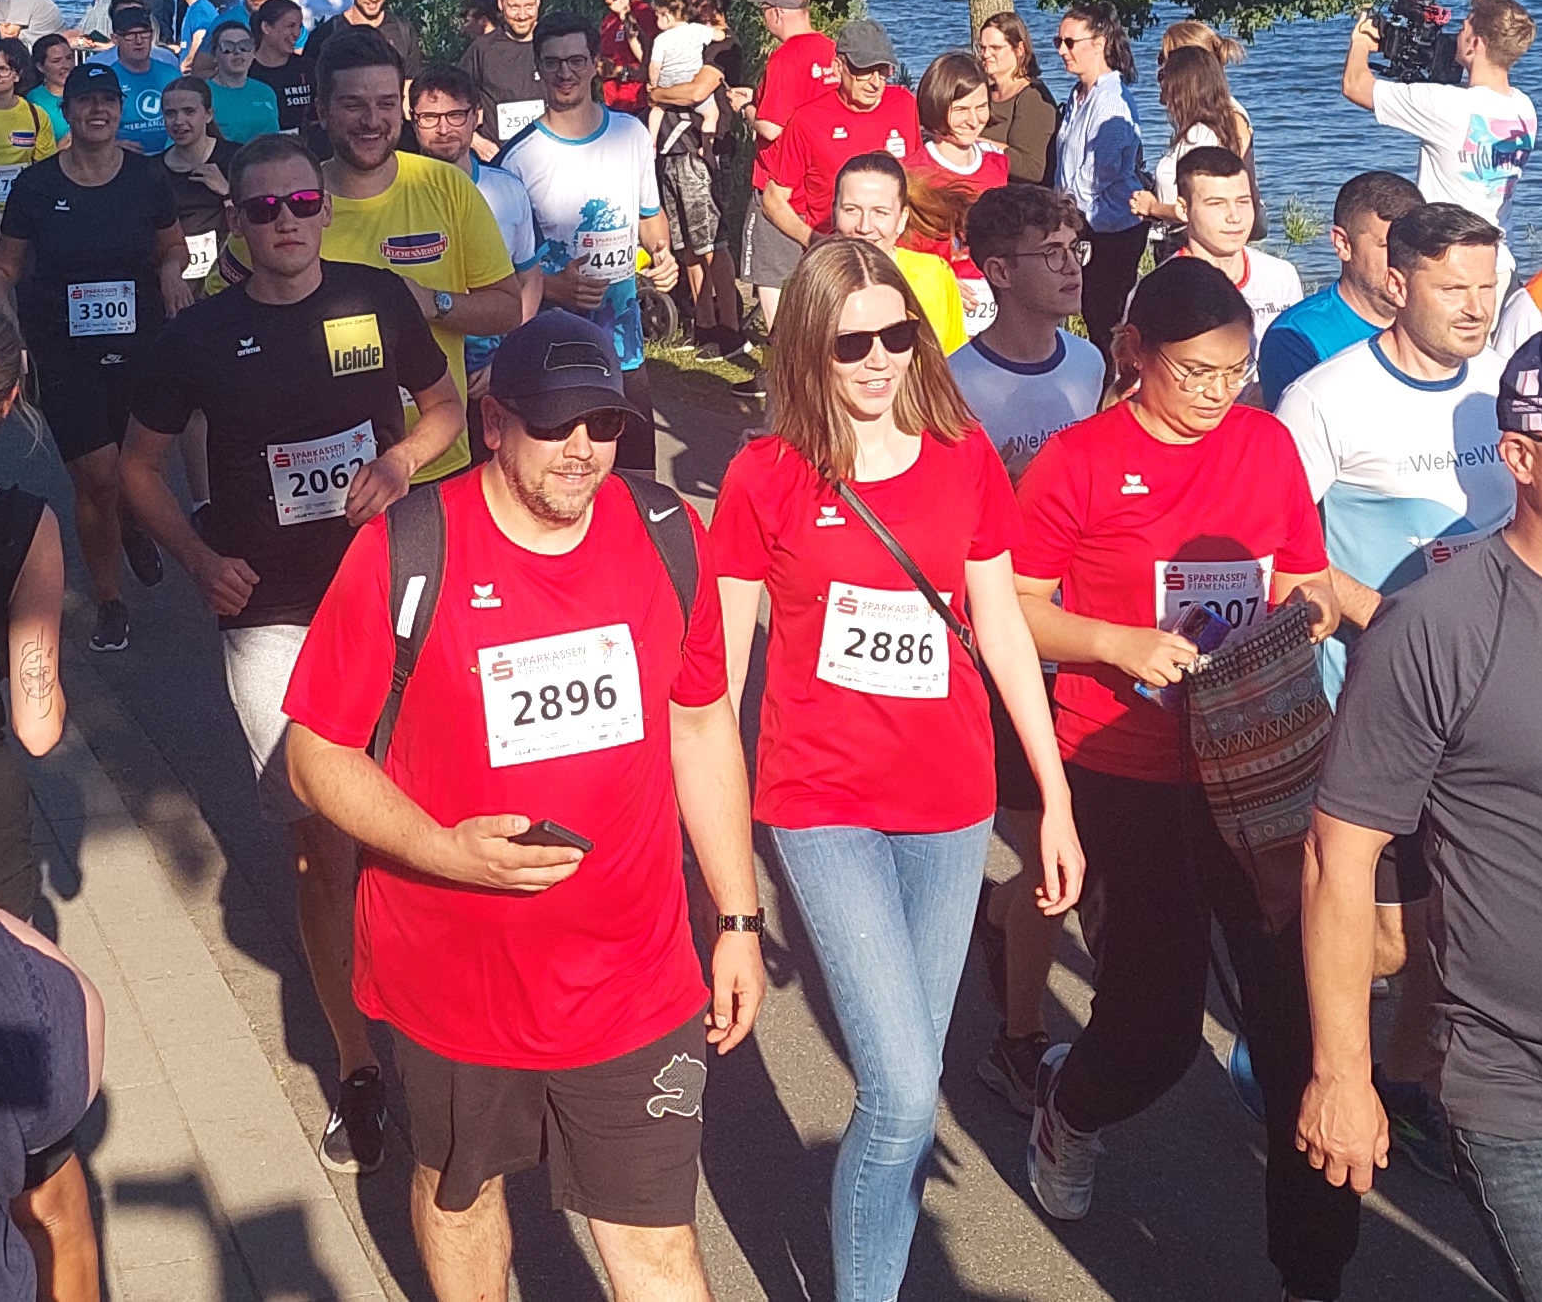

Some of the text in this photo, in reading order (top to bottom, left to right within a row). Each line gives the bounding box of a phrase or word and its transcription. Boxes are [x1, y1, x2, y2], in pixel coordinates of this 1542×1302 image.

[188, 251, 209, 265] 01
[590, 245, 633, 269] 4420
[79, 301, 127, 320] 3300
[334, 344, 380, 372] Lehde
[291, 441, 346, 460] SPARKASSEN
[293, 450, 346, 467] FIRMENLAUF
[1187, 573, 1247, 583] SPARKASSEN
[1188, 582, 1246, 591] FIRMENLAUF
[861, 601, 919, 614] SPARKASSEN
[1179, 595, 1259, 629] 07
[844, 627, 933, 665] 2886
[516, 646, 586, 668] SPARKASSEN
[511, 674, 617, 726] 2896
